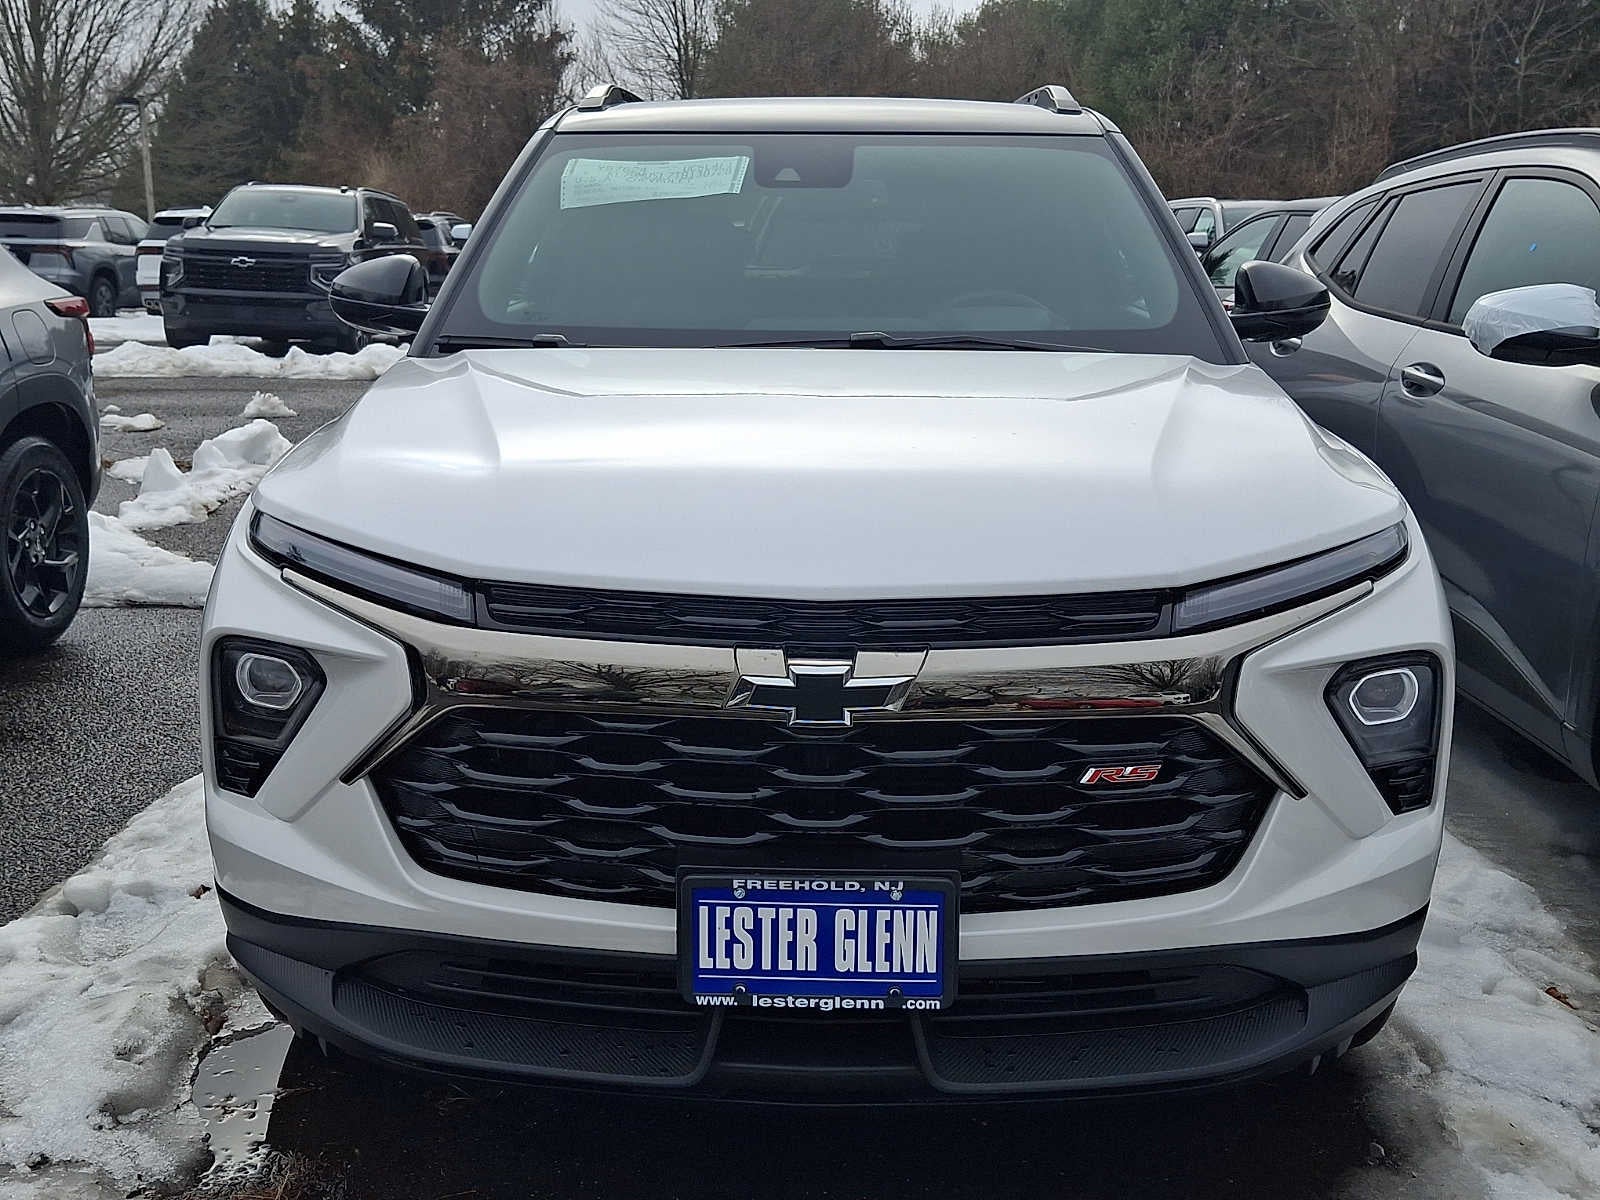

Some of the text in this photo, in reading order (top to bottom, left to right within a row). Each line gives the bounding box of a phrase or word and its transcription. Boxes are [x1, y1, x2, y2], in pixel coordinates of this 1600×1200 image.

[1080, 764, 1161, 784] RS
[732, 879, 904, 892] FREEHOLD, NJ
[699, 905, 938, 973] LESTER GLENN
[696, 995, 941, 1011] www. lesterglenn .com
